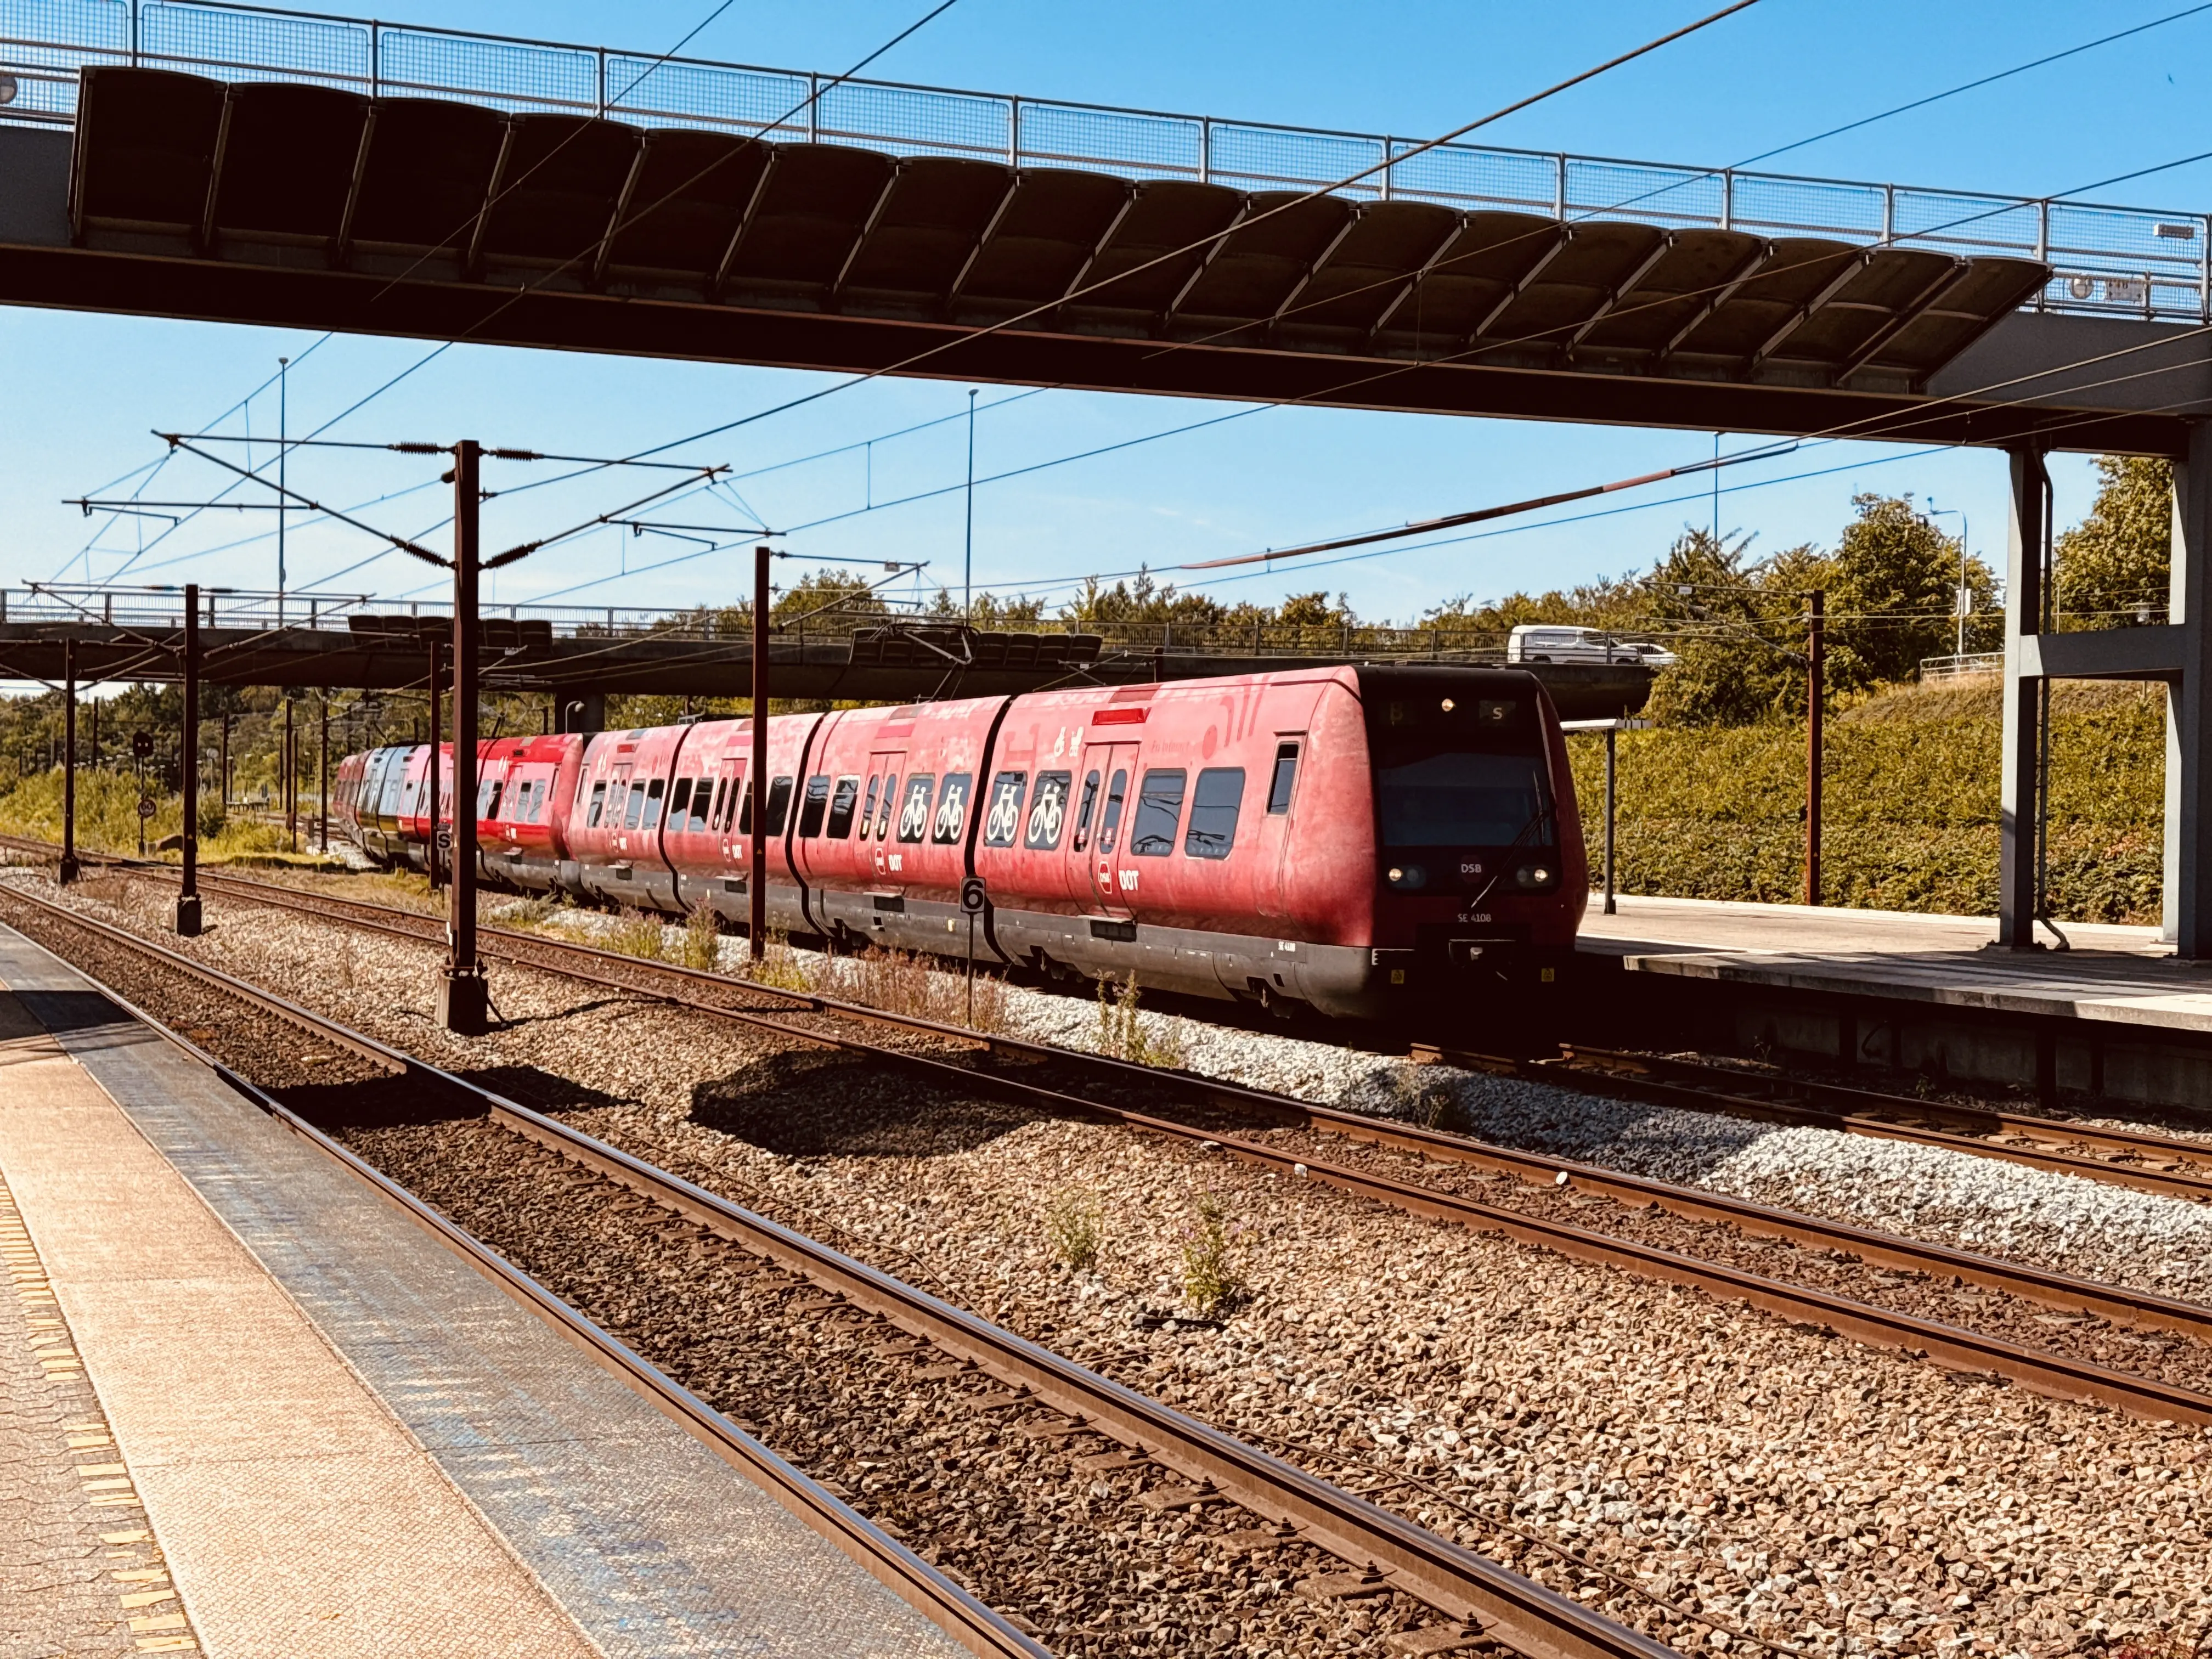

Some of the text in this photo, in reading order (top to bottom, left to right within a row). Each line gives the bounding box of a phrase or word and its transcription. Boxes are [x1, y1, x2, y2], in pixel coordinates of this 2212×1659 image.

[1492, 707, 1503, 719] S
[438, 833, 450, 849] S
[888, 854, 902, 871] DOT
[1461, 864, 1482, 873] DSB
[1119, 870, 1139, 890] DOT
[962, 880, 984, 910] 6
[1457, 913, 1492, 922] SE 4108
